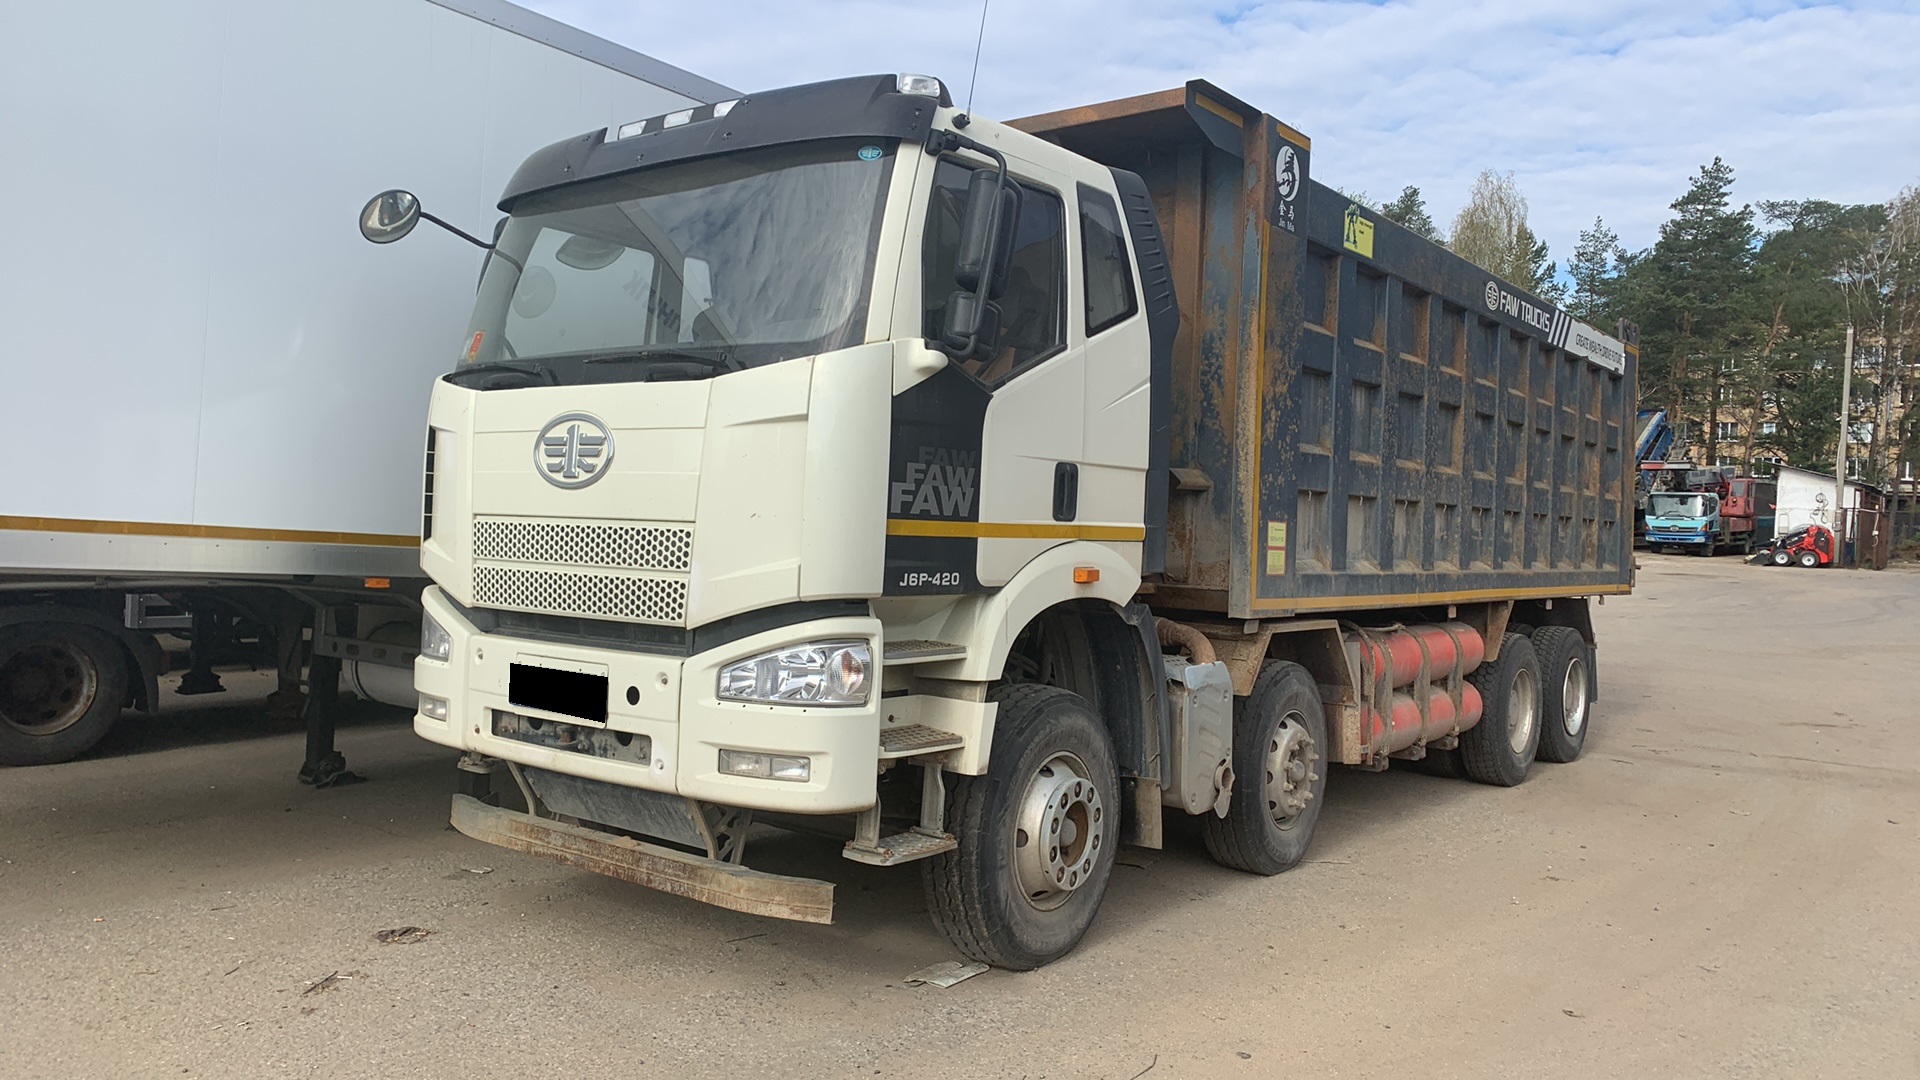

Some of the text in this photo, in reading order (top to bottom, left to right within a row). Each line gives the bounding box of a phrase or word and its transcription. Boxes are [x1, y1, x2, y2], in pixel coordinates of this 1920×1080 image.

[1500, 291, 1550, 333] FAW TRUCKS
[919, 446, 976, 467] FAW
[906, 462, 976, 493] FAW
[890, 481, 975, 517] FAW
[899, 572, 960, 587] J6P-420
